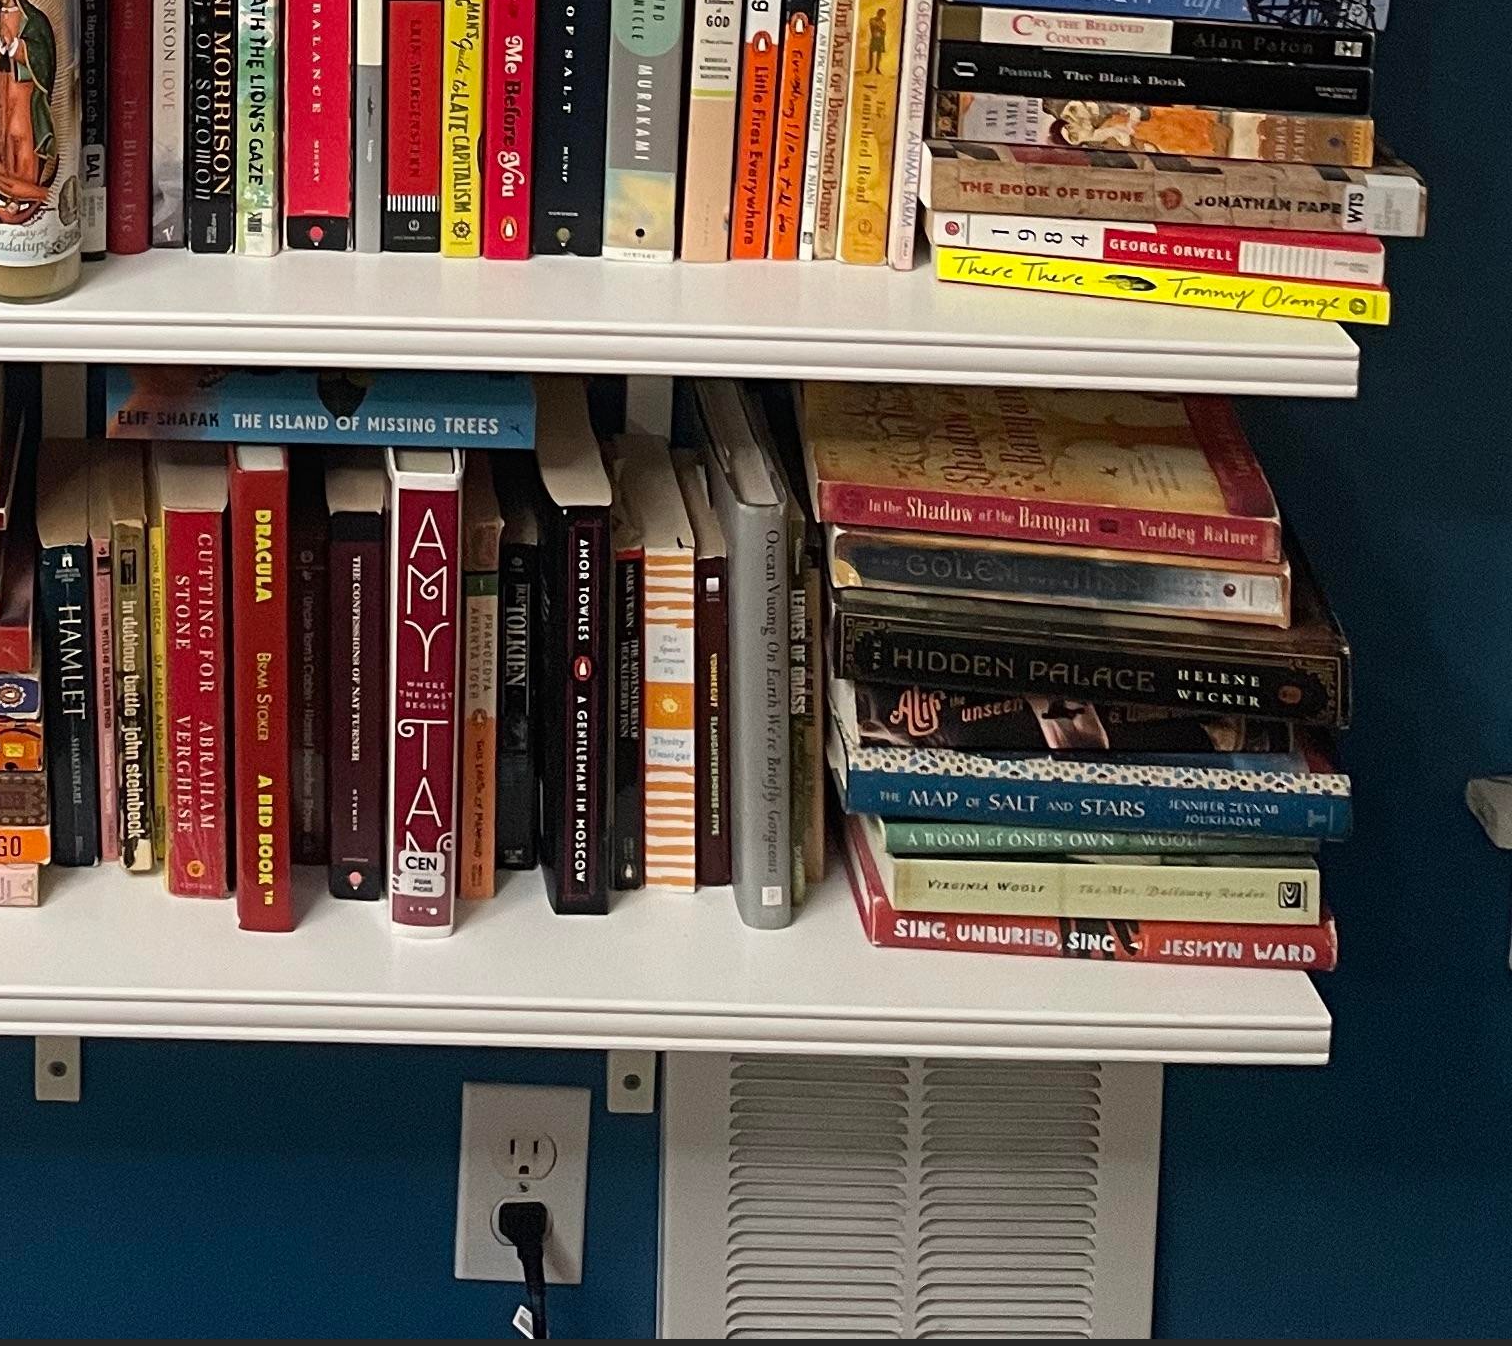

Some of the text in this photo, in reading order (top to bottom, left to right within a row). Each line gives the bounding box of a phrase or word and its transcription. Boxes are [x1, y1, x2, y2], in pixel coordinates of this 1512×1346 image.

[212, 30, 233, 196] MORRISON
[1109, 238, 1233, 262] GEORGE ORWELL
[952, 255, 1340, 313] There There Tommy Orange
[232, 412, 499, 435] THE ISLAND OF MISSING TREES
[255, 509, 274, 604] DRACULA
[57, 603, 87, 721] HAMLET
[891, 644, 1157, 694] HIDDEN PALACE
[405, 855, 439, 873] CEN
[893, 918, 1117, 953] SING, UNBURIED, SING
[1159, 937, 1317, 965] JESMYN WARD
